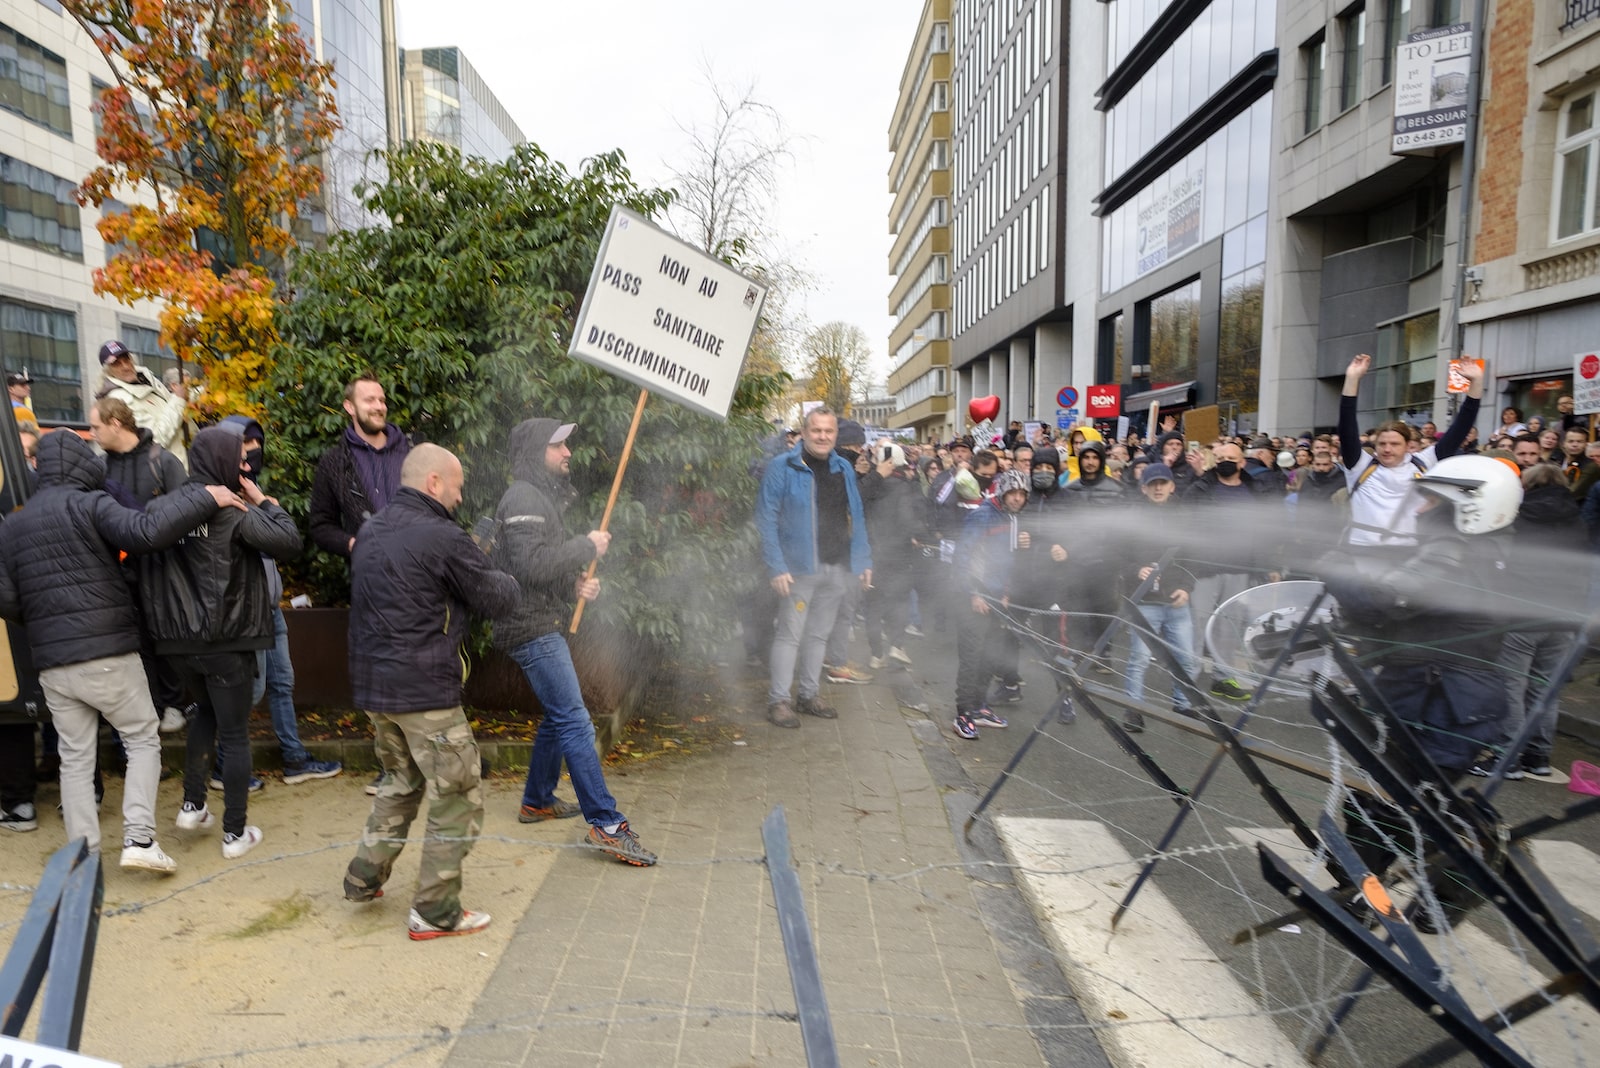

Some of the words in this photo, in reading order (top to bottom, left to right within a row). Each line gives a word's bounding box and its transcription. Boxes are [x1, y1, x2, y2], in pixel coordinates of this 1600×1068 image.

[1405, 44, 1431, 60] TO
[1438, 36, 1472, 54] LET
[1412, 29, 1450, 42] Schuman
[1407, 110, 1467, 128] BELSQUAR
[1396, 136, 1410, 146] 02
[1413, 131, 1436, 143] 648
[1440, 128, 1454, 139] 20
[602, 263, 642, 296] PASS
[658, 254, 690, 285] NON
[698, 276, 718, 299] AU
[653, 307, 724, 357] SANITAIRE
[587, 325, 710, 397] DISCRIMINATION
